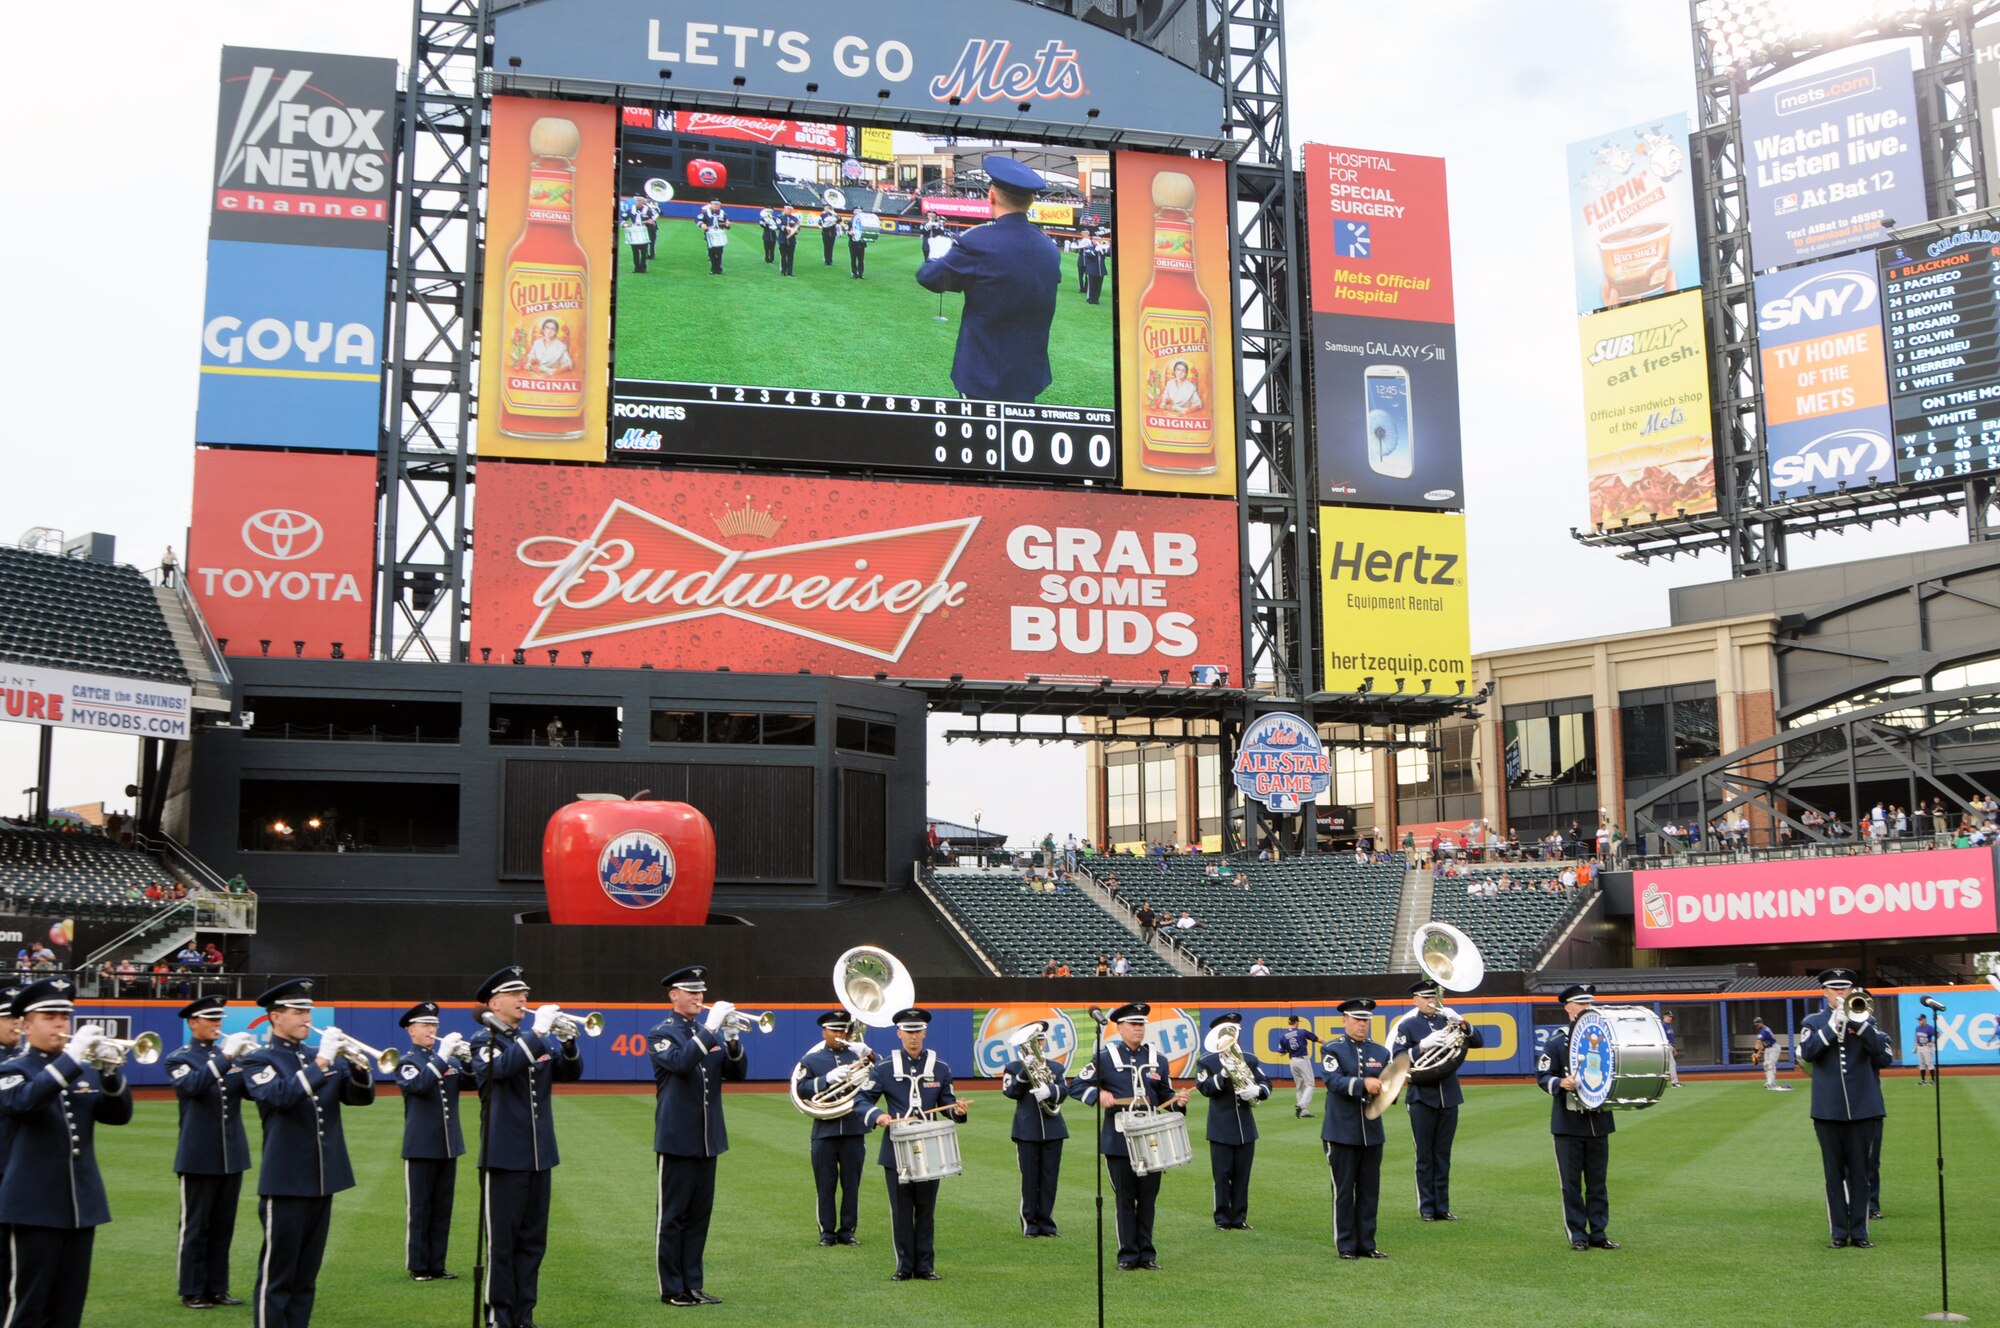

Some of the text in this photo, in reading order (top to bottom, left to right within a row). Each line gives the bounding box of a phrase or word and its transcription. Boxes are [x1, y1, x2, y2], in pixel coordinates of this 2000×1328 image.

[647, 19, 1086, 103] LET'S GO Mets
[1781, 74, 1870, 110] mets.com
[278, 102, 386, 151] FOX
[802, 127, 830, 137] SOME
[864, 127, 893, 141] Hertz
[1754, 108, 1908, 162] Watch live.
[795, 132, 837, 147] BUDS
[245, 145, 385, 193] NEWS
[1328, 151, 1396, 172] HOSPITAL
[1757, 136, 1908, 188] Listen live.
[1329, 167, 1358, 183] FOR
[1330, 183, 1395, 202] SPECIAL
[1800, 170, 1896, 210] At Bat 12
[221, 194, 383, 219] channel
[530, 210, 572, 222] ORIGINAL
[960, 204, 990, 214] DONUTS
[1040, 209, 1071, 221] SNACKS
[1330, 199, 1405, 219] SURGERY
[1785, 209, 1884, 240] Text AtBat to 48593
[1794, 220, 1882, 248] to download At Bat
[1927, 229, 2000, 257] COLORADO
[1156, 258, 1193, 270] ORIGINAL
[1889, 253, 1970, 279] 8 BLACKMON
[1334, 268, 1431, 291] Mets Official
[1888, 270, 1962, 294] 22 PACHECO
[510, 281, 584, 312] CHOLULA
[1334, 285, 1399, 304] Hospital
[1759, 282, 1858, 331] SNY
[1889, 286, 1955, 308] 24 FOWLER
[526, 303, 549, 314] HOT
[1891, 300, 1953, 322] 12 BROWN
[1907, 314, 1960, 333] ROSARIO
[203, 316, 375, 366] GOYA
[1143, 325, 1208, 356] CHOLULA
[1325, 341, 1364, 356] Samsung
[1366, 341, 1419, 358] GALAXY
[1587, 318, 1688, 367] SUBWAY
[1774, 332, 1869, 369] TV HOME
[1893, 328, 1955, 350] 21 COLVIN
[1158, 346, 1180, 357] HOT
[1896, 340, 1971, 363] 9 LEMAHIEU
[1606, 342, 1700, 387] eat fresh.
[1798, 364, 1849, 387] OF THE
[1896, 356, 1965, 377] 18 HERRERA
[512, 378, 578, 391] ORIGINAL
[1899, 372, 1955, 391] 6 WHITE
[710, 387, 996, 417] 1 2 3 4 5 6 7 8 9 R H E
[1590, 391, 1703, 422] Official sandwich shop
[1796, 387, 1855, 416] METS
[1922, 396, 1945, 410] ON
[1947, 389, 1978, 405] THE
[614, 403, 997, 440] ROCKIES 0 0 0
[1005, 407, 1111, 423] BALLS STRIKES OUTS
[1150, 417, 1208, 430] ORIGINAL
[1609, 406, 1685, 436] of the Mets
[1927, 408, 1978, 427] WHITE
[614, 428, 997, 465] Mets 0 0 0
[1902, 434, 1917, 445] W
[1927, 432, 1936, 441] L
[1957, 426, 1967, 436] K
[1905, 446, 1916, 459] 2
[1927, 442, 1938, 455] 6
[1954, 436, 1972, 450] 45
[1011, 429, 1111, 467] 0 0 0
[1920, 450, 1971, 467] IP BB
[1771, 442, 1871, 488] SNY
[1914, 461, 1972, 481] 69.0 33
[1331, 486, 1357, 495] verizon
[1006, 524, 1199, 576] GRAB
[516, 535, 968, 615] Budweiser
[1330, 541, 1459, 586] Hertz
[198, 567, 363, 603] TOYOTA
[1040, 574, 1168, 607] SOME
[1347, 593, 1443, 612] Equipment Rental
[1010, 605, 1199, 658] BUDS
[1331, 651, 1464, 676] hertzequip.com
[72, 685, 187, 710] CATCH the SAVINGS!
[72, 708, 185, 736] MYBOBS.COM
[1267, 729, 1298, 746] Mets
[1256, 773, 1312, 795] GAME
[1317, 817, 1344, 826] verizon
[610, 858, 664, 886] Mets
[1677, 877, 1982, 923] DUNKIN' DONUTS
[611, 1033, 647, 1057] 40
